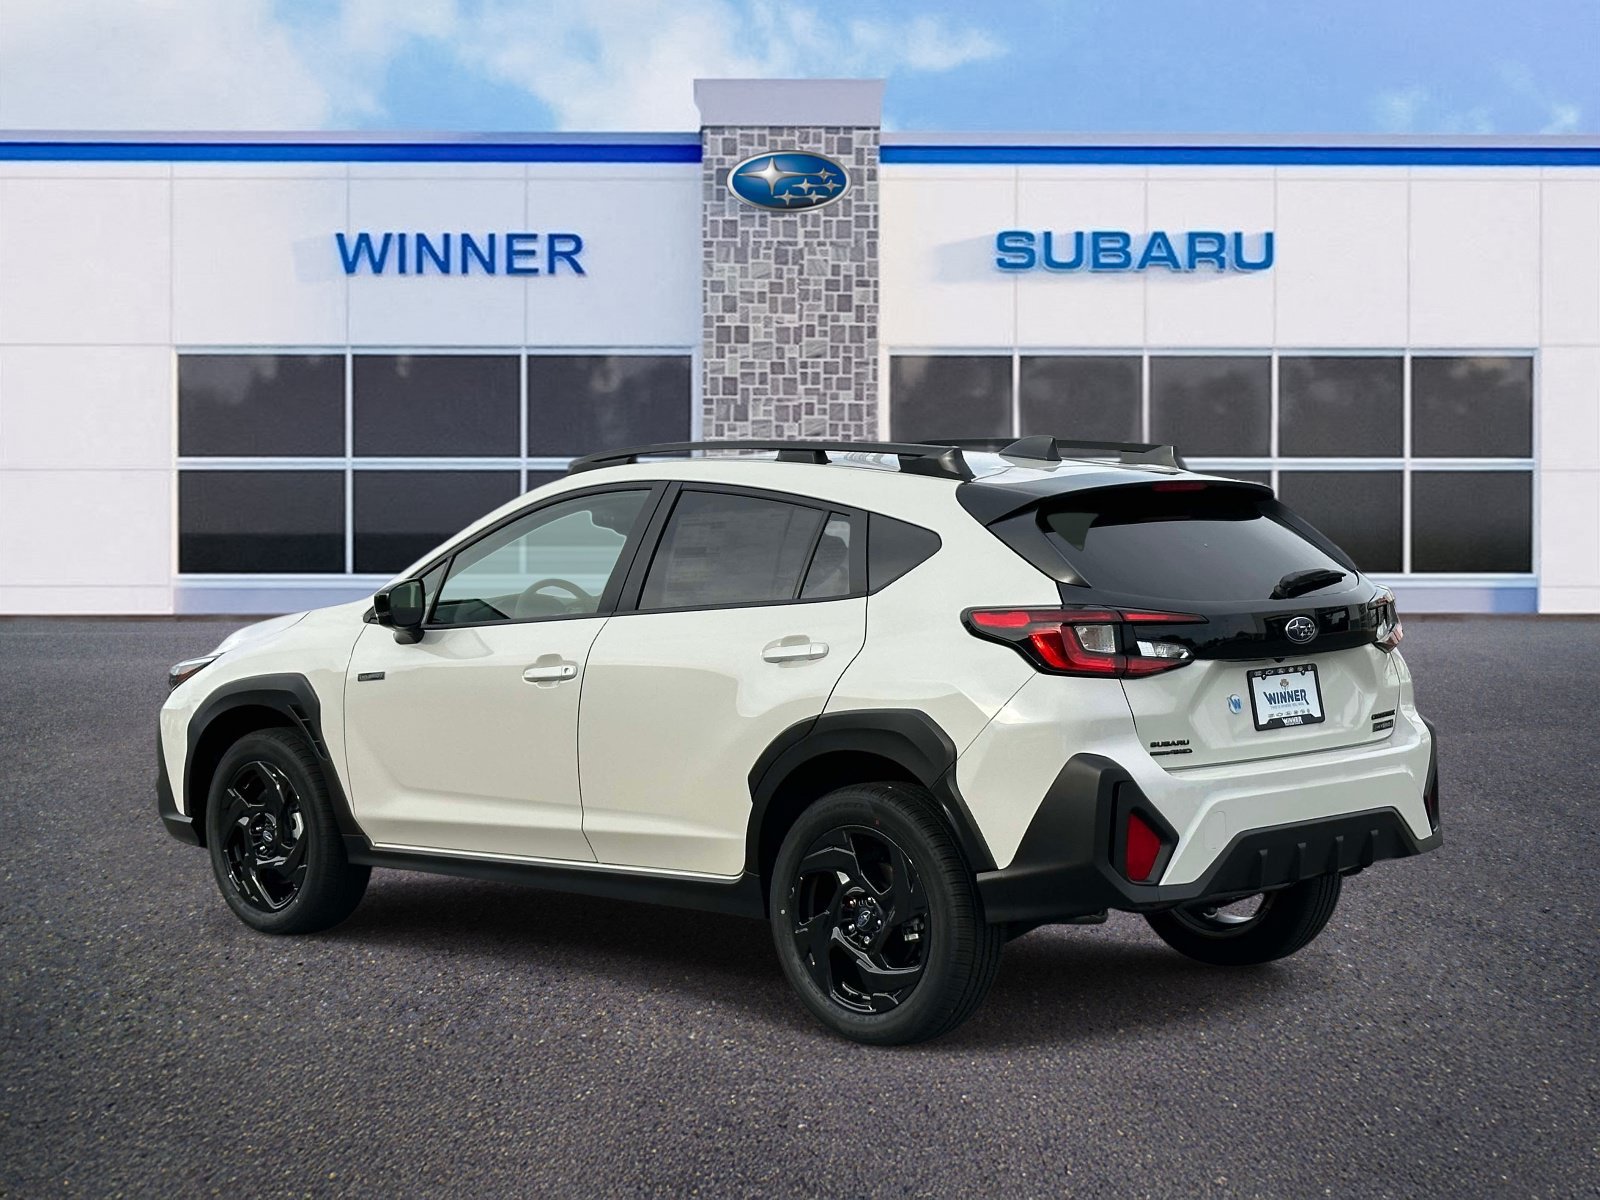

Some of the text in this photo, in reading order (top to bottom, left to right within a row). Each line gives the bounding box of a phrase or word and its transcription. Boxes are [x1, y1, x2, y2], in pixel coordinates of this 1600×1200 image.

[335, 232, 586, 274] WINNER
[995, 230, 1275, 272] SUBARU
[1263, 689, 1309, 705] WINNER
[1150, 739, 1190, 748] SUBARU
